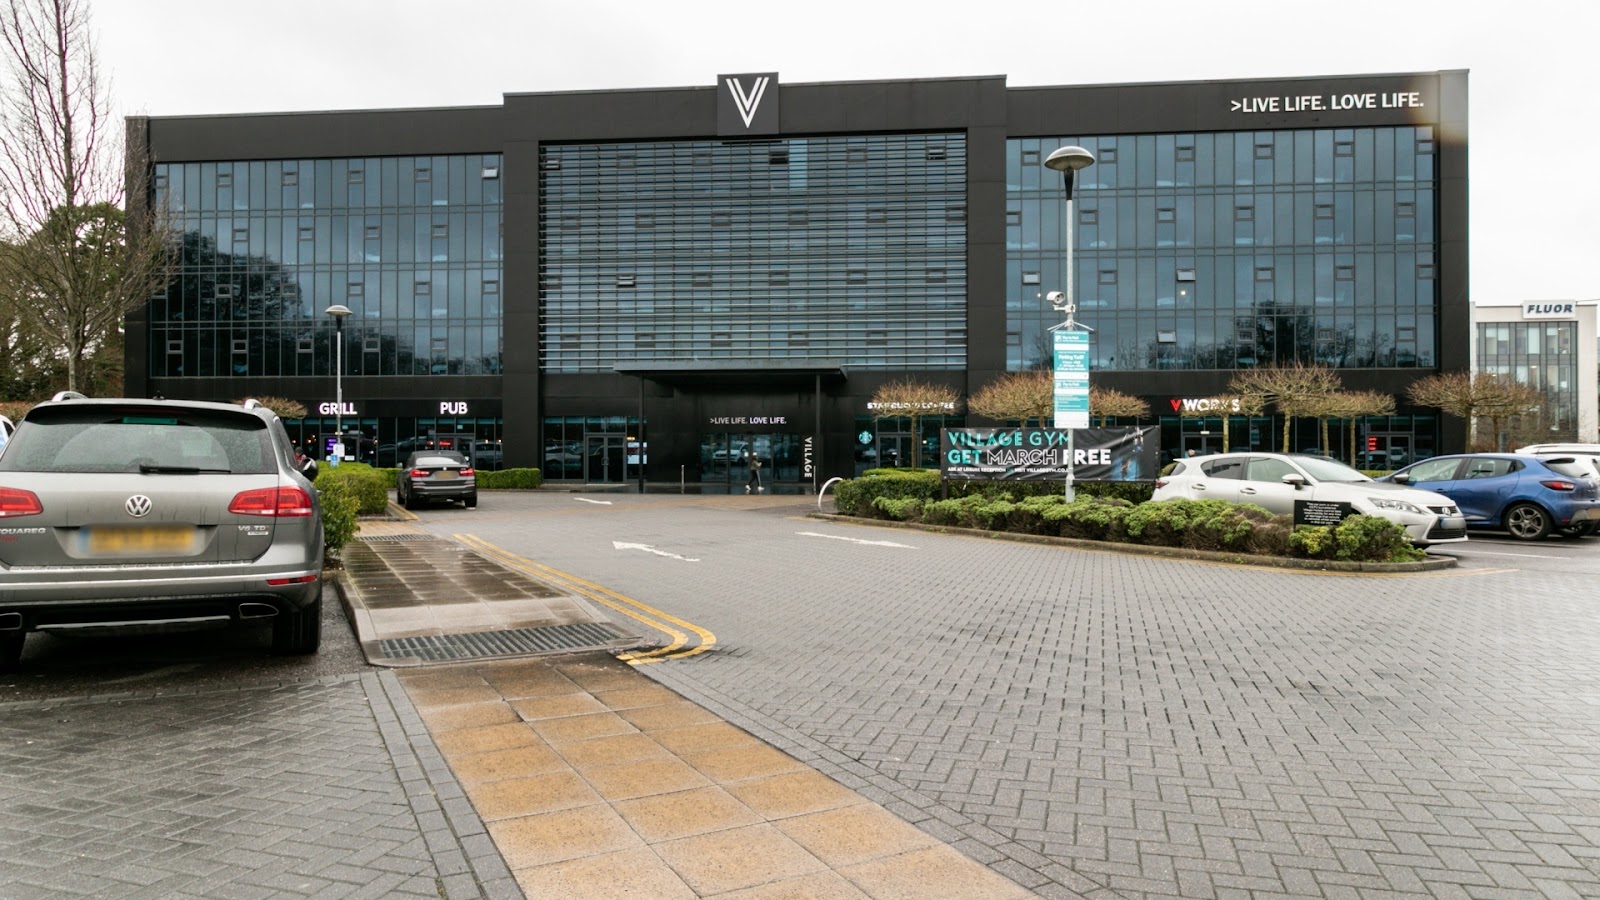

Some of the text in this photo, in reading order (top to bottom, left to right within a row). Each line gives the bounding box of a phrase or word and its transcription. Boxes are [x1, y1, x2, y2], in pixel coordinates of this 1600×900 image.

[1230, 91, 1425, 113] >LIVE LIFE. LOVE LIFE.
[1527, 304, 1573, 314] FLUOR
[319, 402, 358, 415] GRILL
[440, 401, 469, 415] PUB
[948, 431, 1069, 447] VILLAGE GYM
[804, 436, 812, 478] VILLAGE
[948, 449, 1111, 465] GET MARCH FREE
[0, 527, 46, 535] OUAREG
